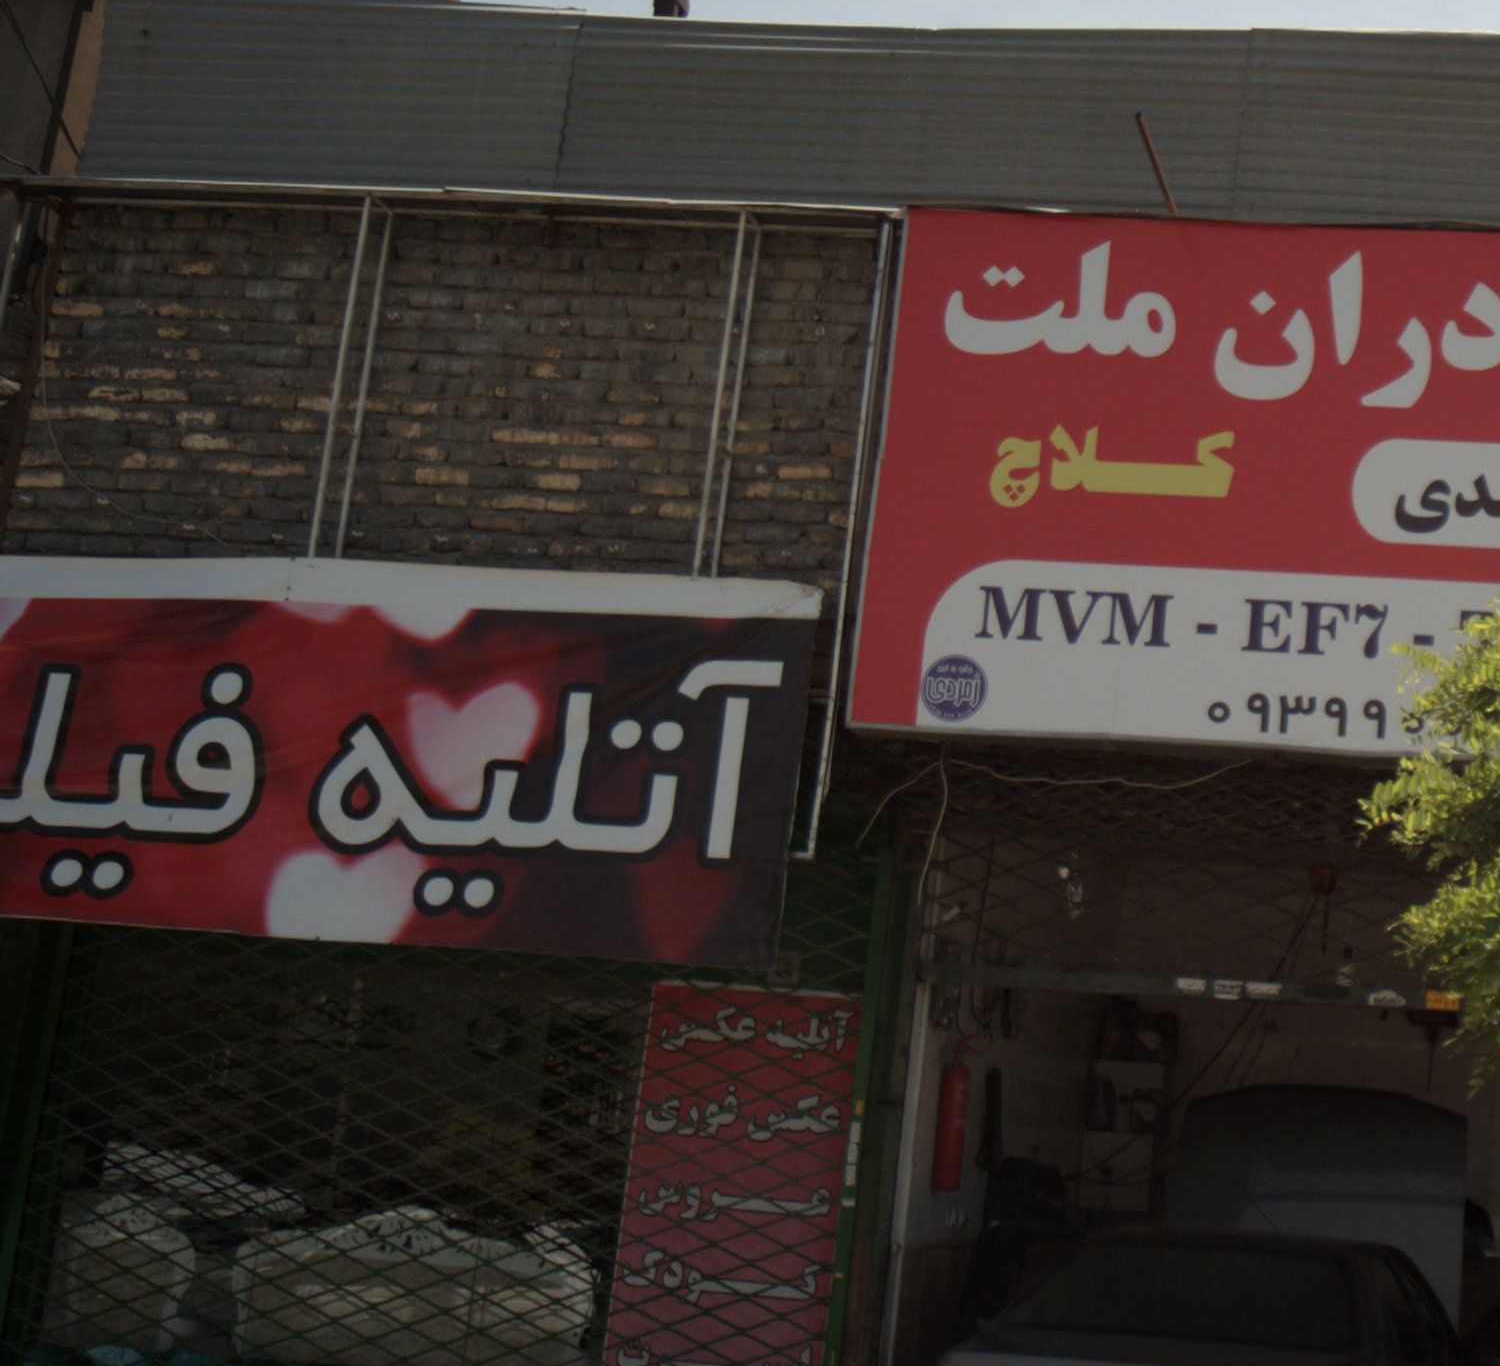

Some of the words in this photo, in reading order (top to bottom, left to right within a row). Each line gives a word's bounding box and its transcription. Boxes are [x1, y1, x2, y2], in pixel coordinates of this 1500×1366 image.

[943, 240, 1178, 357] ملت
[989, 424, 1236, 508] کلاچ
[974, 584, 1175, 649] MVM
[1241, 598, 1389, 660] EF7
[0, 662, 264, 900] فیل
[310, 659, 785, 918] آتلیه
[660, 1007, 758, 1052] عکس
[765, 1009, 856, 1060] آتلیه
[644, 1083, 740, 1137] فوری
[747, 1095, 841, 1141] عکس
[637, 1182, 833, 1222] عروس
[622, 1249, 834, 1304] کودک
